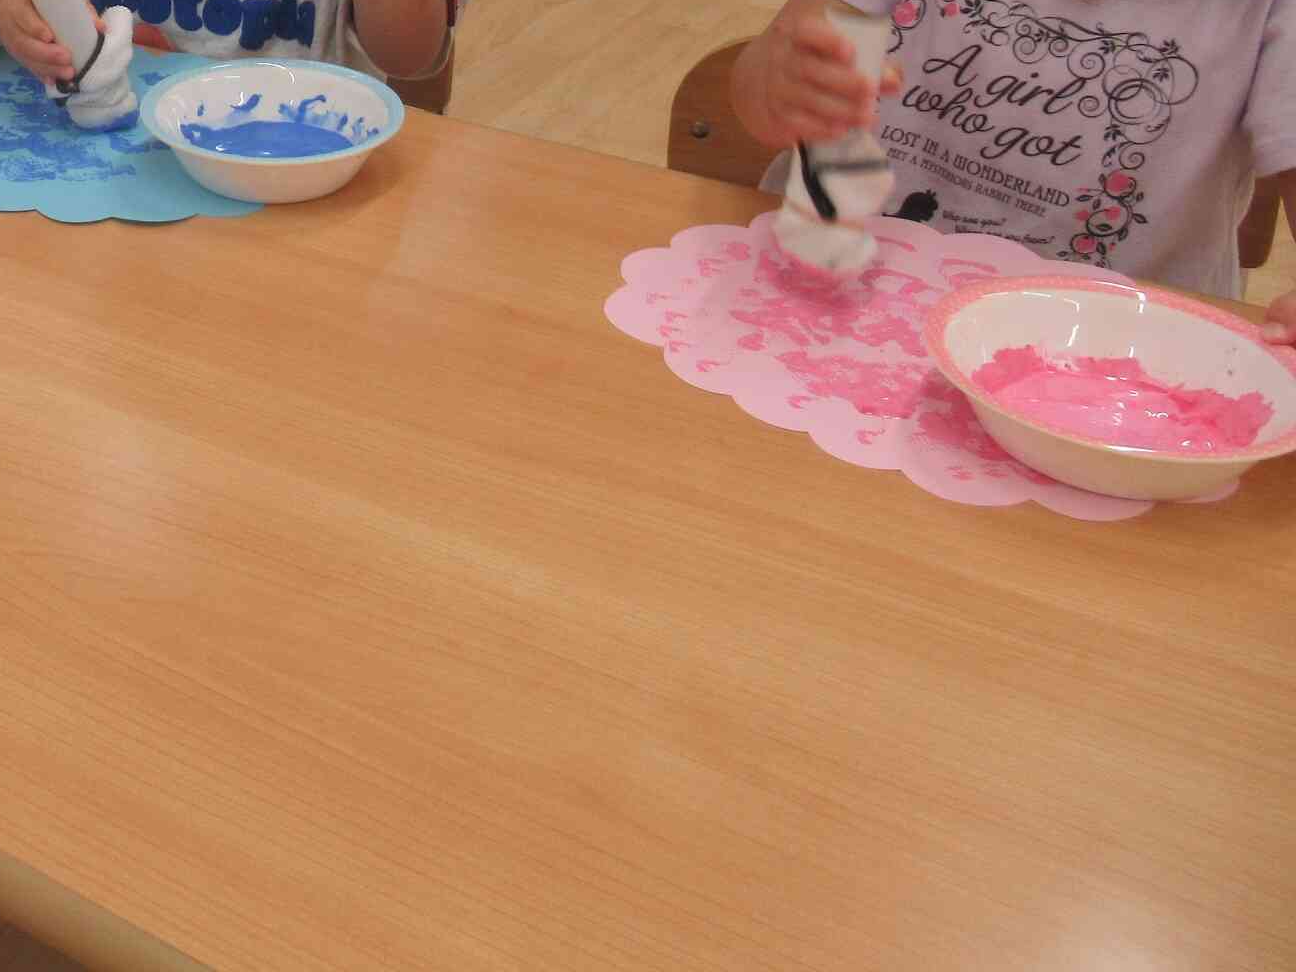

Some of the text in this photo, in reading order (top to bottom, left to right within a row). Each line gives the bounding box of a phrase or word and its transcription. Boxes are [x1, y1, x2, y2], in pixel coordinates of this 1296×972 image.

[922, 44, 1087, 115] A girl
[902, 85, 1083, 166] who got
[881, 125, 1070, 208] LOST IN A WONDERLAND
[975, 183, 1012, 205] RABBIT
